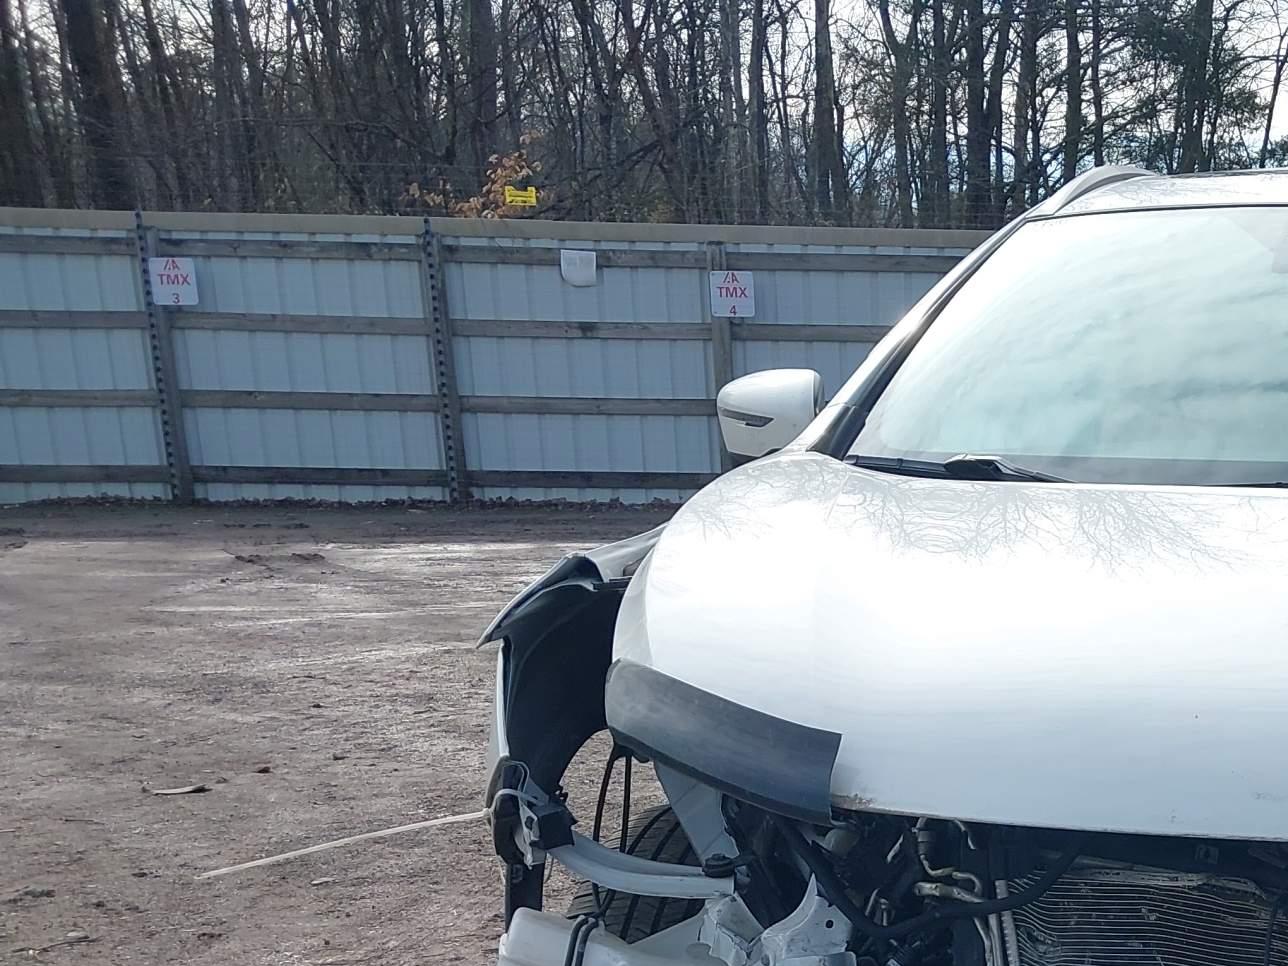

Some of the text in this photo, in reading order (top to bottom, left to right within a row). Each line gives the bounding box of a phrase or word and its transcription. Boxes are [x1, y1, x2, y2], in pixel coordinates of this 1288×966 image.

[157, 273, 191, 286] TMX
[171, 292, 180, 304] 3
[716, 286, 748, 298] TMX
[729, 304, 737, 316] 4
